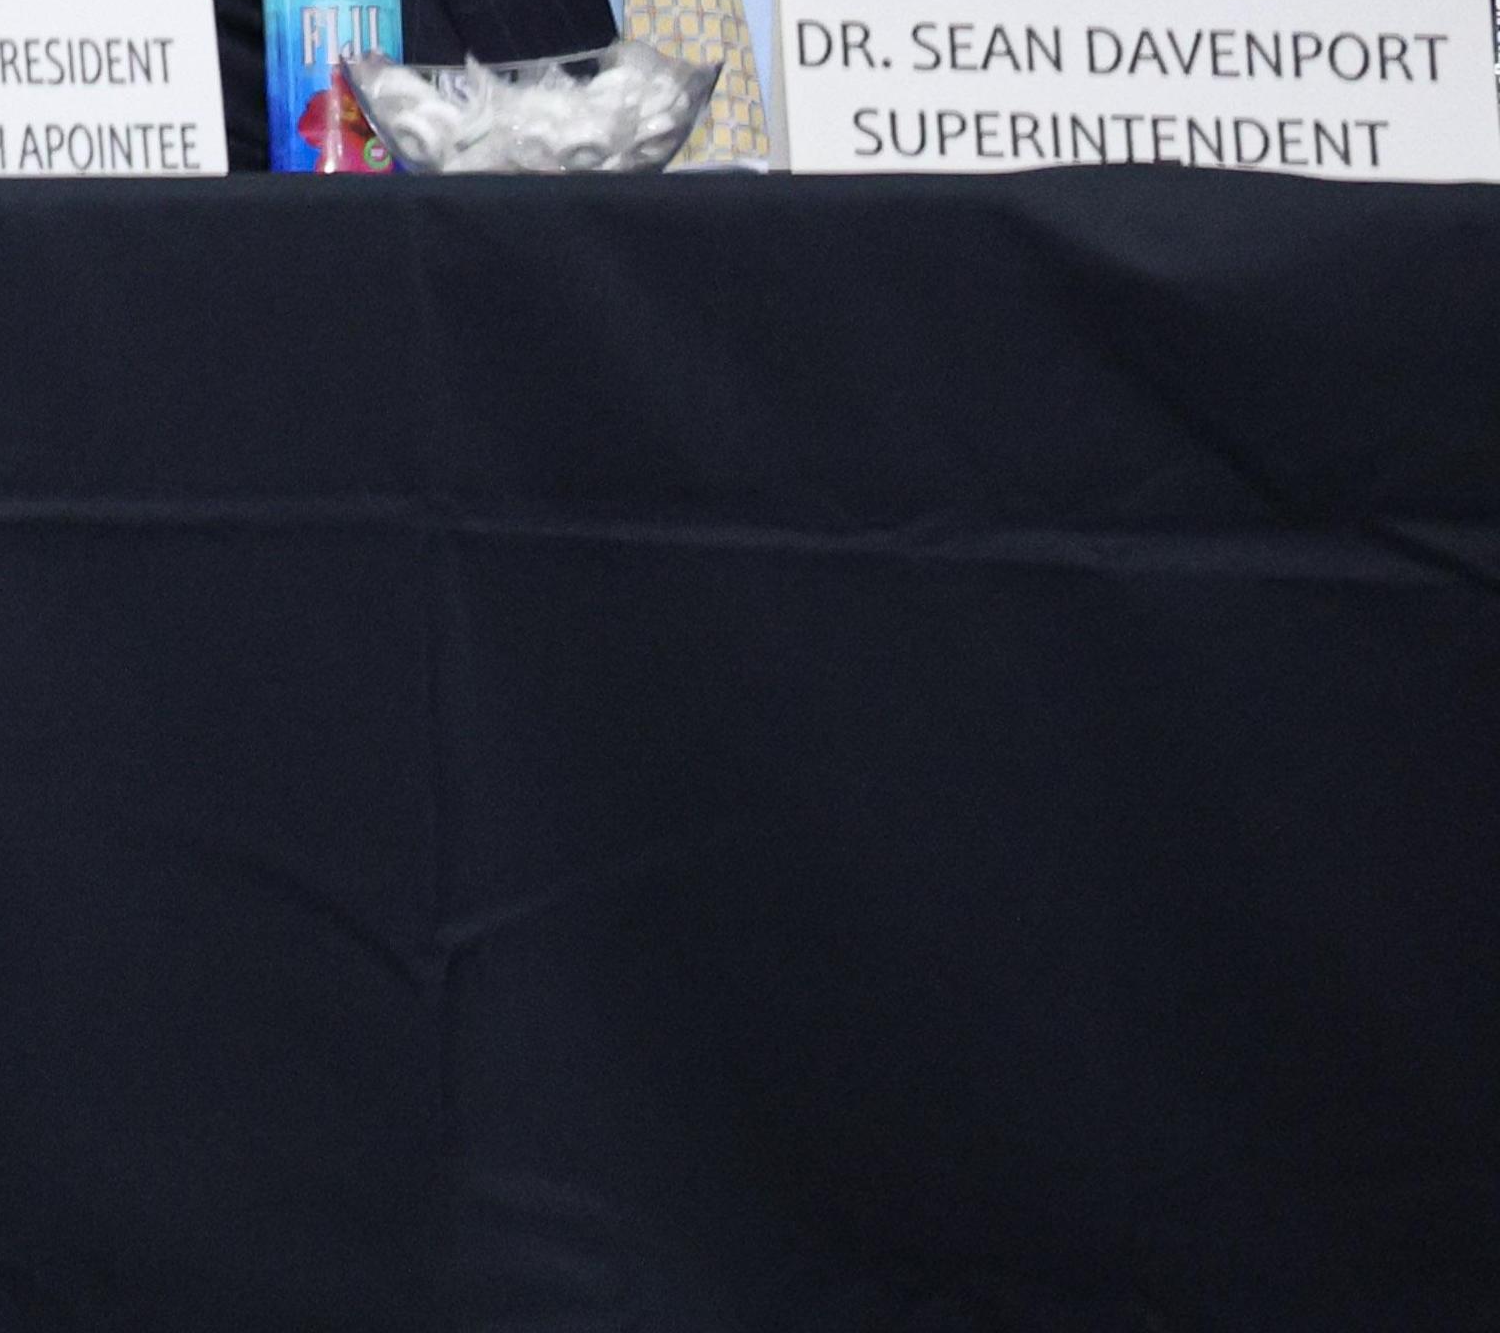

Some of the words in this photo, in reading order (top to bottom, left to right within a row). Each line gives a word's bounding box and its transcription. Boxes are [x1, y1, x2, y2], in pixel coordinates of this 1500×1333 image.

[303, 5, 380, 66] FIJI
[796, 21, 891, 68] DR.
[911, 23, 1064, 73] SEAN
[1085, 27, 1449, 82] DAVENPORT
[18, 123, 202, 172] APOINTEE
[852, 108, 1390, 169] SUPERINTENDENT
